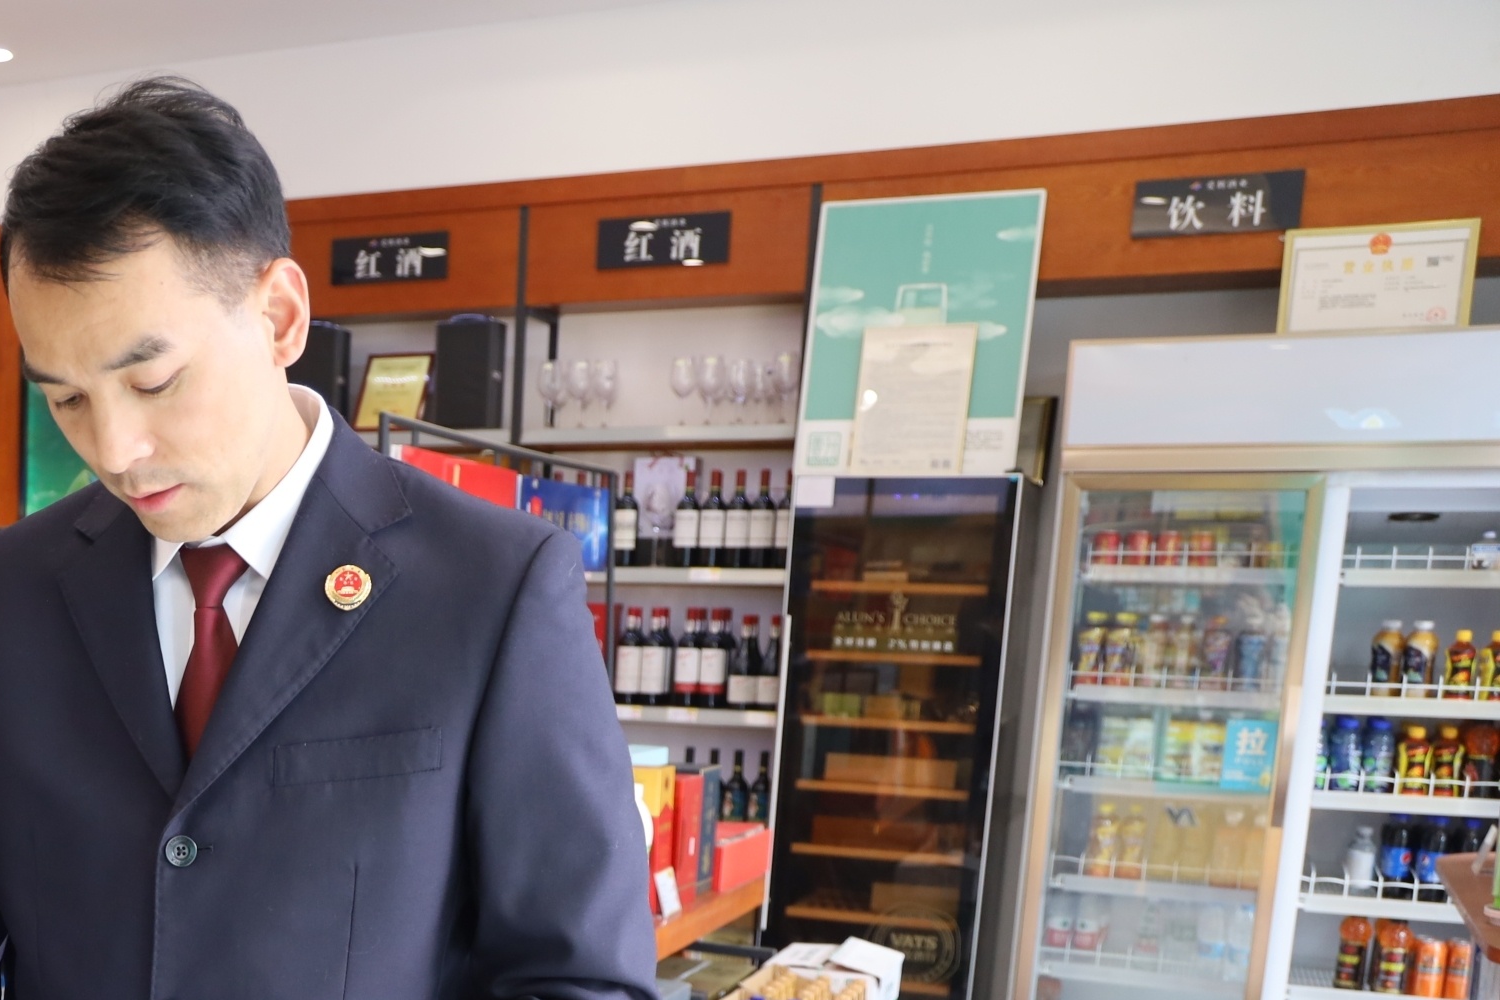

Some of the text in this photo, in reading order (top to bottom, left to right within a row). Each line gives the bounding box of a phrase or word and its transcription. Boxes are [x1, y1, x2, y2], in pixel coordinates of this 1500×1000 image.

[1167, 190, 1266, 231] 饮料
[624, 228, 703, 263] 红酒
[355, 247, 422, 279] 红酒
[1235, 727, 1269, 756] 拉
[890, 932, 939, 951] VATS
